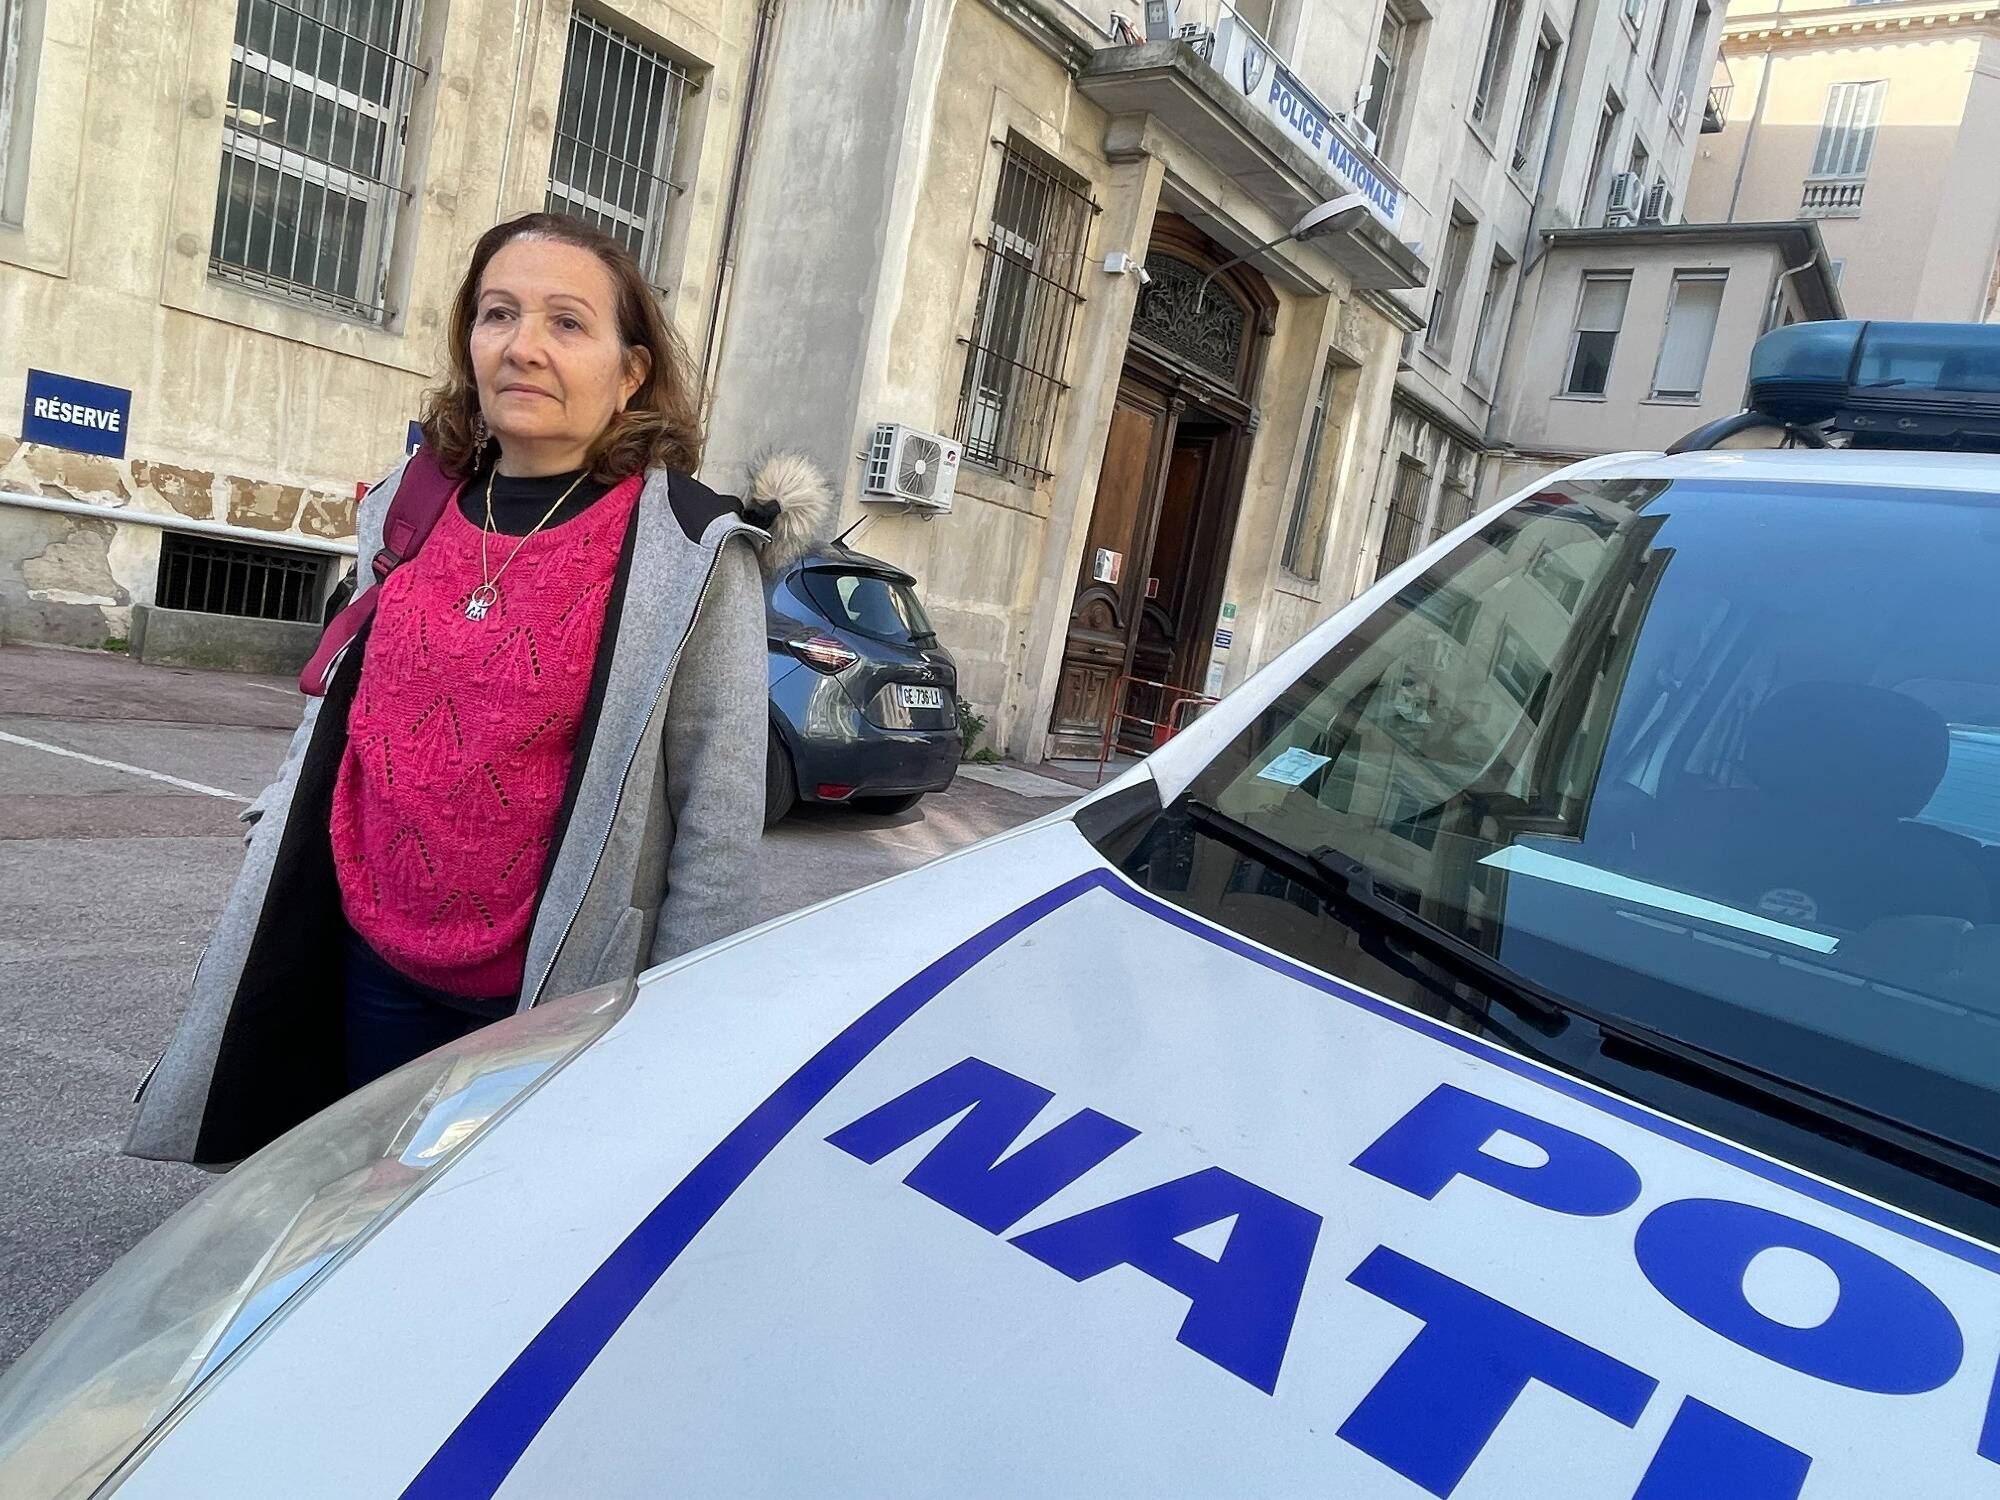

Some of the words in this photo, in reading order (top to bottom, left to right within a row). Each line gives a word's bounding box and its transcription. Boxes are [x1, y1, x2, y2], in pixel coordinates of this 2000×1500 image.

[1268, 78, 1324, 150] POLICE
[1327, 136, 1399, 219] NATIONALE
[34, 395, 121, 433] RÉSERVÉ
[1350, 1082, 2000, 1466] PO
